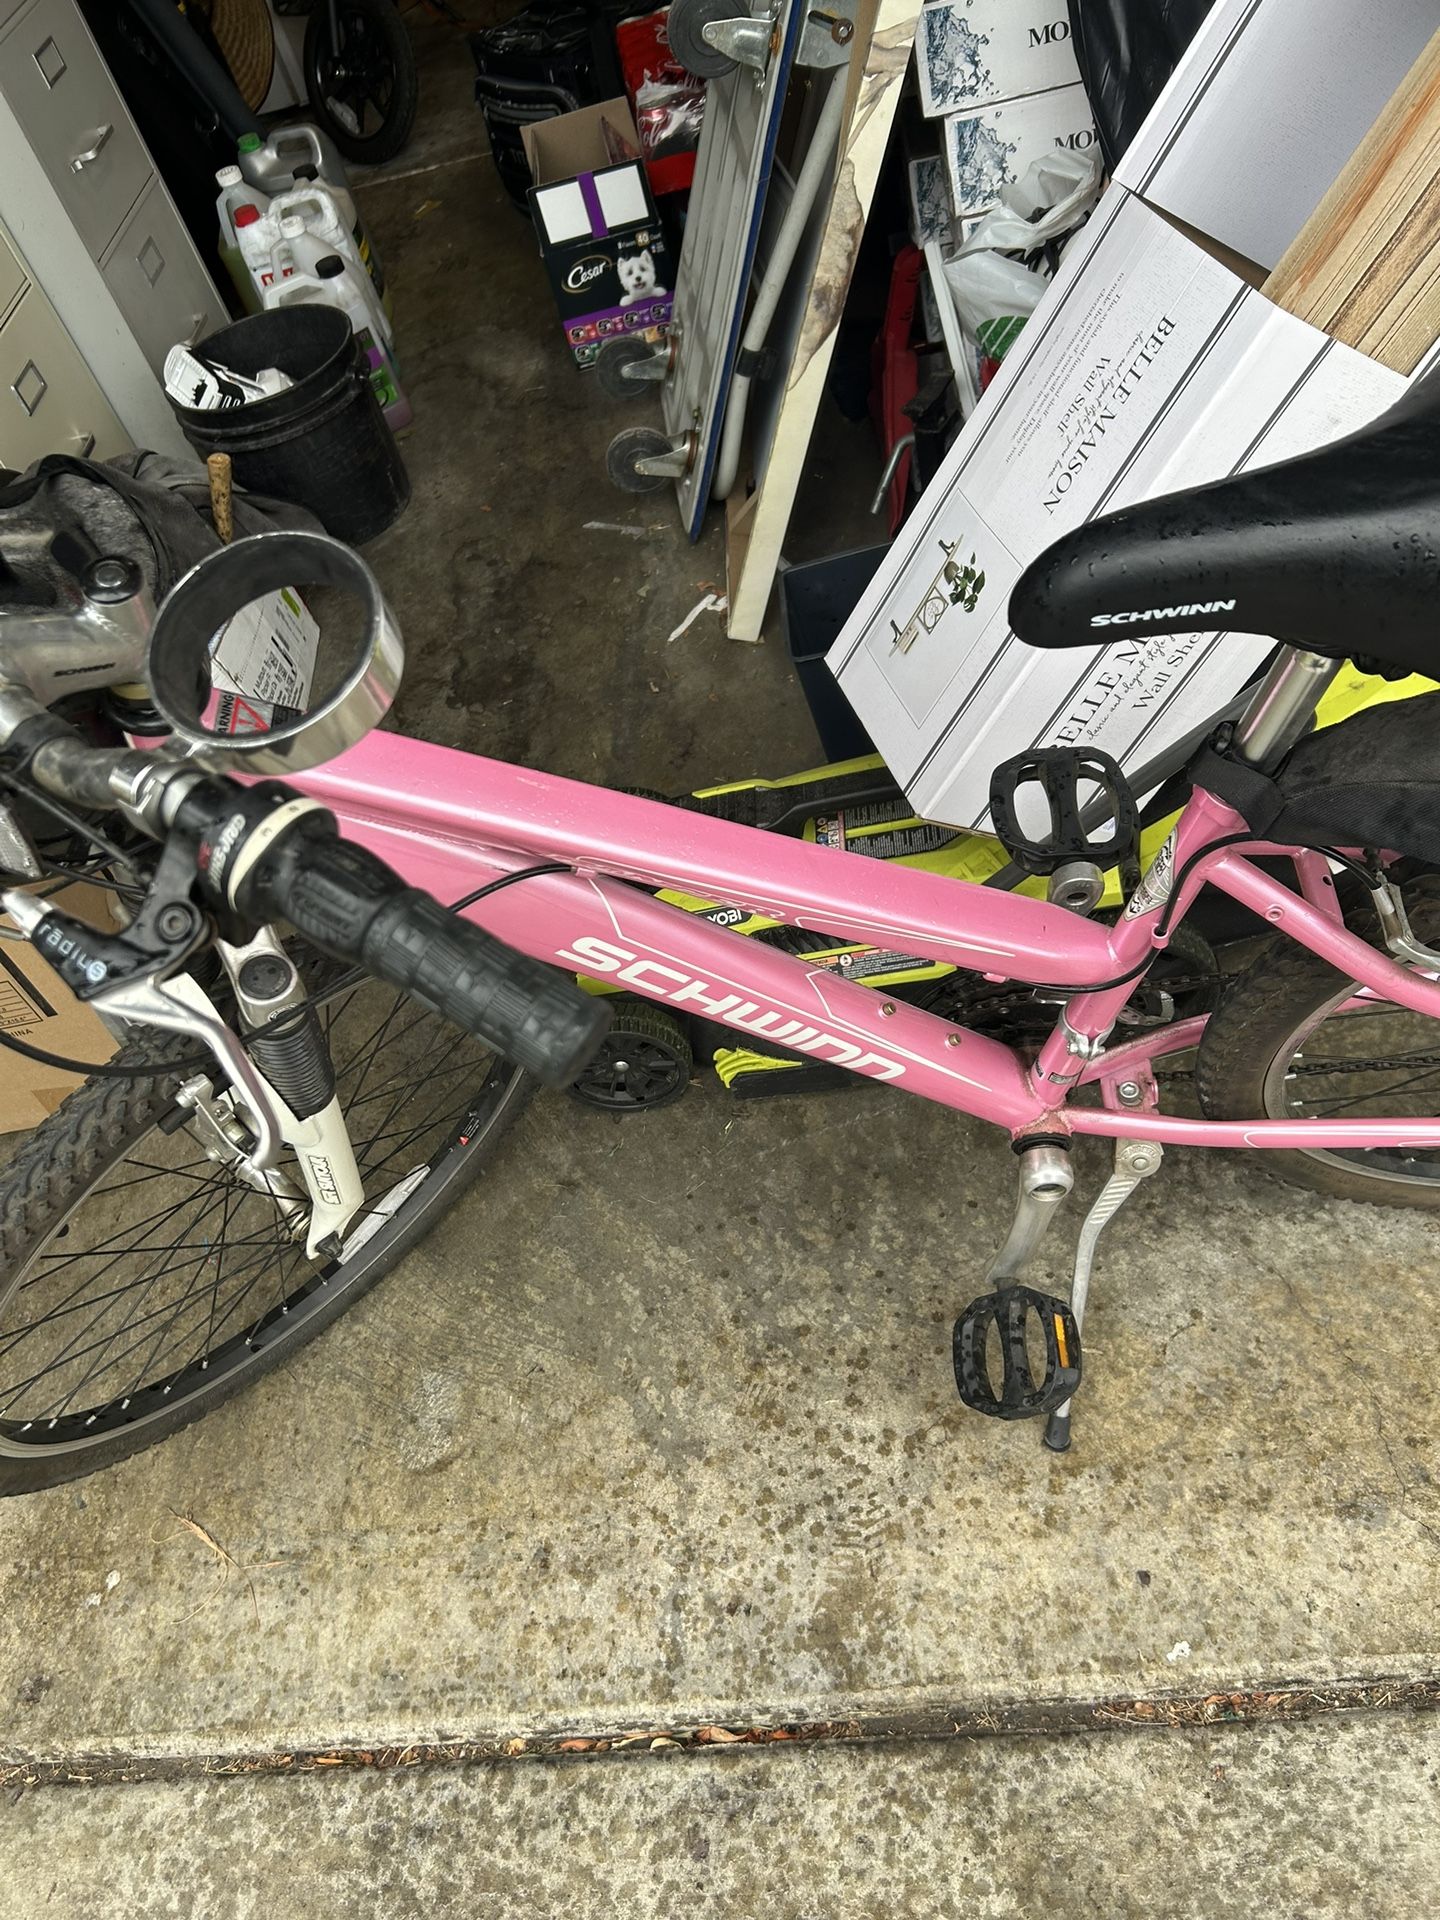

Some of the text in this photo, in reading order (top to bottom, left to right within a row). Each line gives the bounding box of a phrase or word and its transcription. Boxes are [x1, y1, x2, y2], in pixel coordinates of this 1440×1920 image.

[1028, 19, 1072, 48] MO
[1054, 128, 1098, 151] MO
[567, 260, 607, 289] Cesar
[1113, 357, 1126, 377] and
[1116, 315, 1176, 405] BELLE
[1054, 358, 1110, 437] Wall Shelf
[1093, 374, 1115, 407] elegant
[1072, 420, 1084, 438] for
[1081, 404, 1099, 426] style
[1041, 405, 1116, 516] MAISON
[1090, 599, 1237, 627] SCHWINN
[1108, 693, 1125, 713] and
[1121, 658, 1149, 694] elegant
[1146, 638, 1166, 661] style
[1131, 631, 1204, 707] Wall She
[216, 693, 235, 735] ARNING
[1053, 671, 1122, 745] ELLE
[706, 909, 743, 925] YOBI
[554, 936, 907, 1081] SCHWINN
